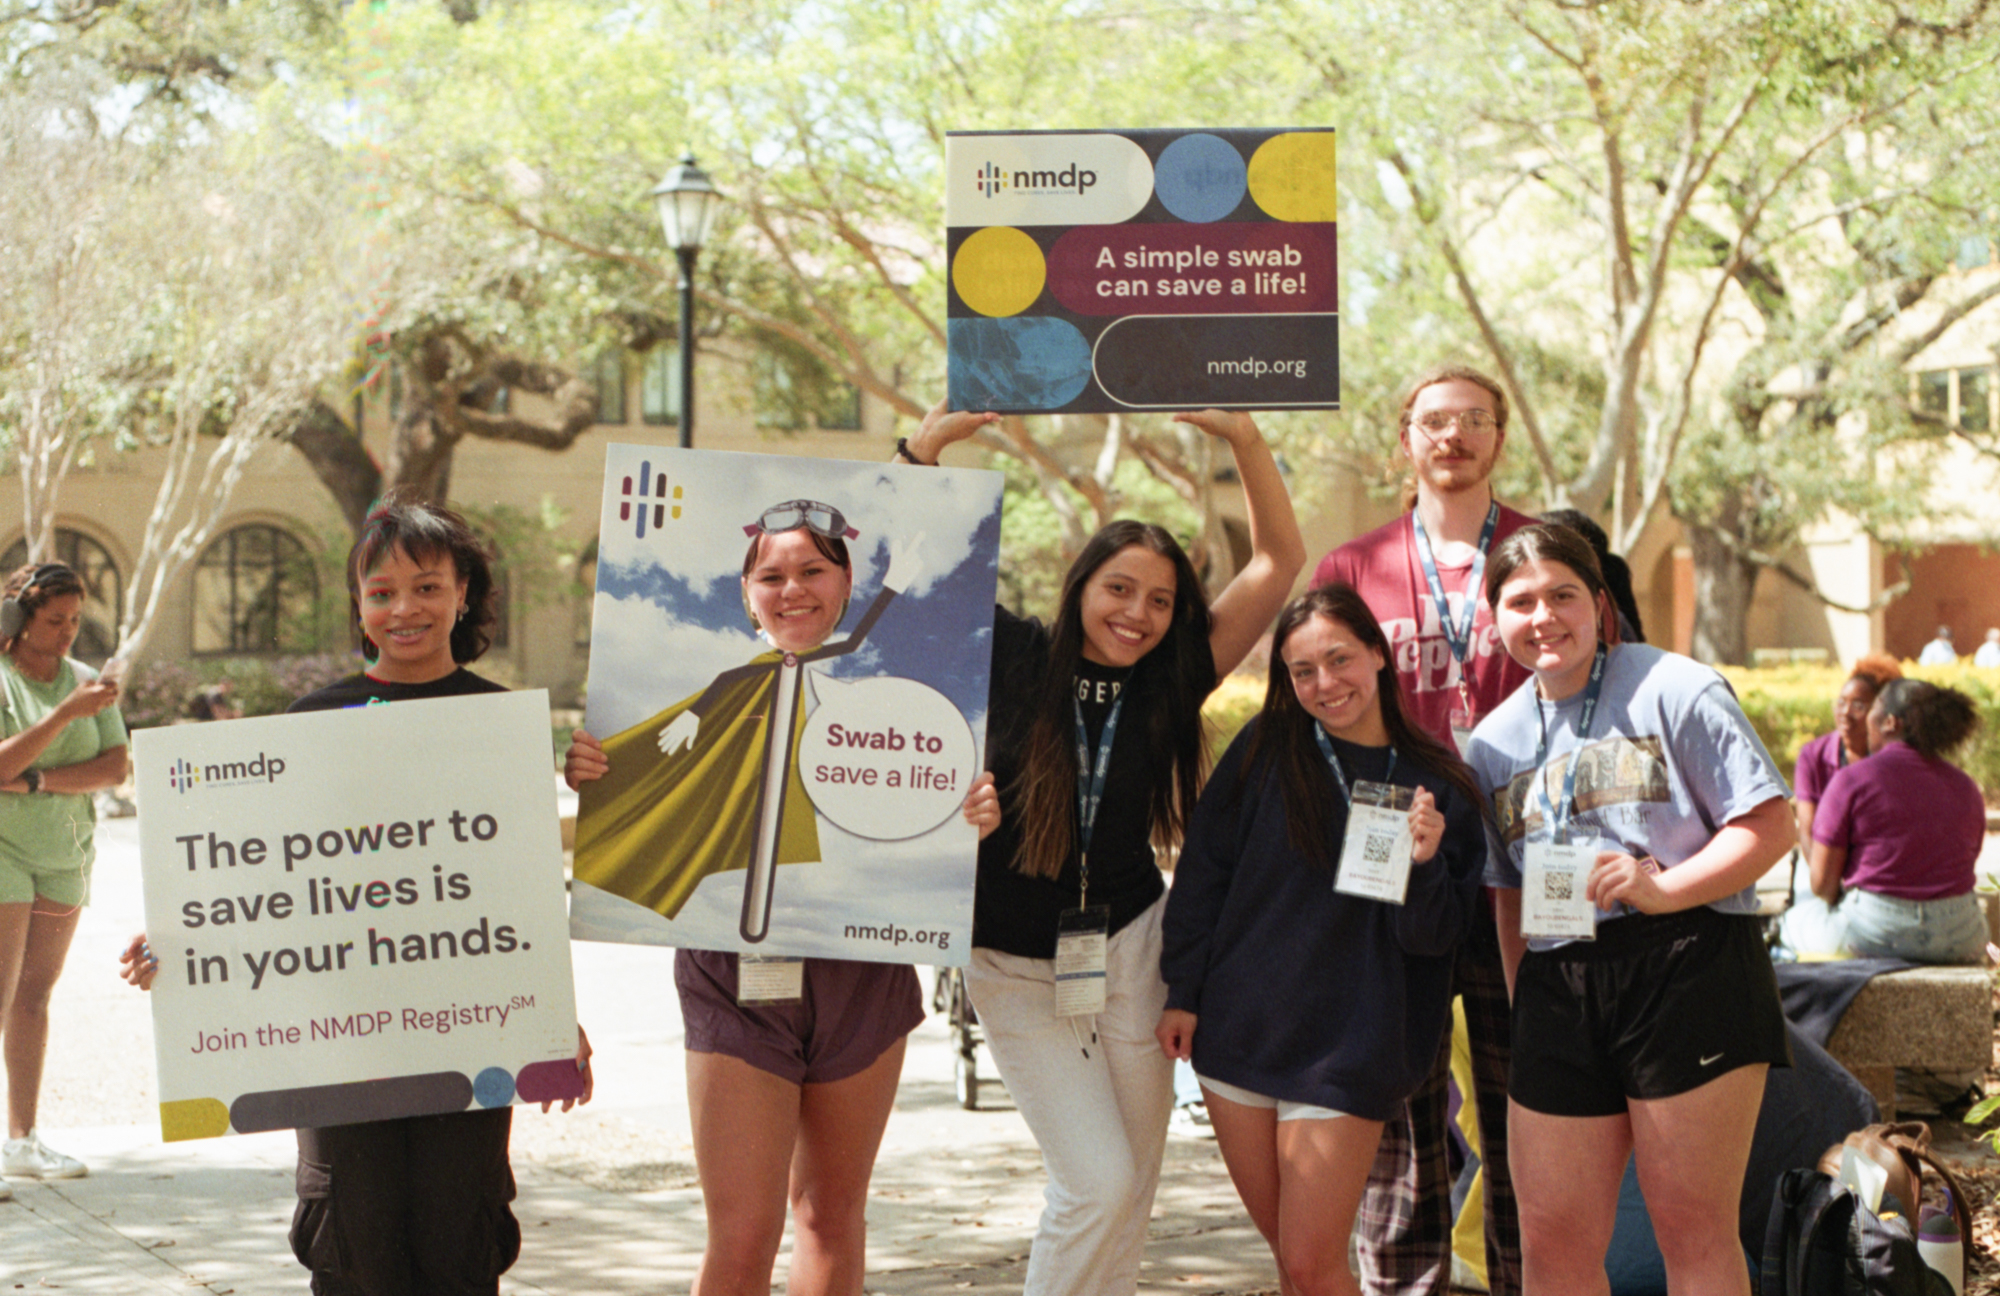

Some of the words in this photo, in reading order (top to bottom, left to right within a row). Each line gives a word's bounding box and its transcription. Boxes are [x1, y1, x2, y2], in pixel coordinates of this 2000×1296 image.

[1013, 162, 1097, 195] nmdp
[1096, 246, 1116, 269] A
[1124, 245, 1220, 274] simple
[1227, 244, 1302, 267] swab
[1096, 279, 1149, 297] can
[1156, 278, 1222, 296] save
[1230, 278, 1246, 295] a
[1254, 272, 1306, 295] life!
[1207, 356, 1307, 379] nmdp.org
[826, 723, 906, 751] Swab
[913, 731, 943, 754] to
[204, 752, 286, 783] nmdp
[815, 764, 878, 786] save
[885, 769, 902, 788] a
[909, 764, 956, 791] life!
[175, 832, 267, 871] The
[282, 818, 435, 872] power
[448, 809, 498, 843] to
[182, 890, 294, 929] save
[308, 877, 419, 916] lives
[432, 864, 472, 902] is
[844, 923, 950, 950] nmdp.org
[185, 948, 229, 986] in
[242, 941, 354, 990] your
[367, 916, 531, 966] hands.
[191, 1028, 247, 1054] Join
[255, 1023, 301, 1047] the
[310, 1010, 393, 1041] NMDP
